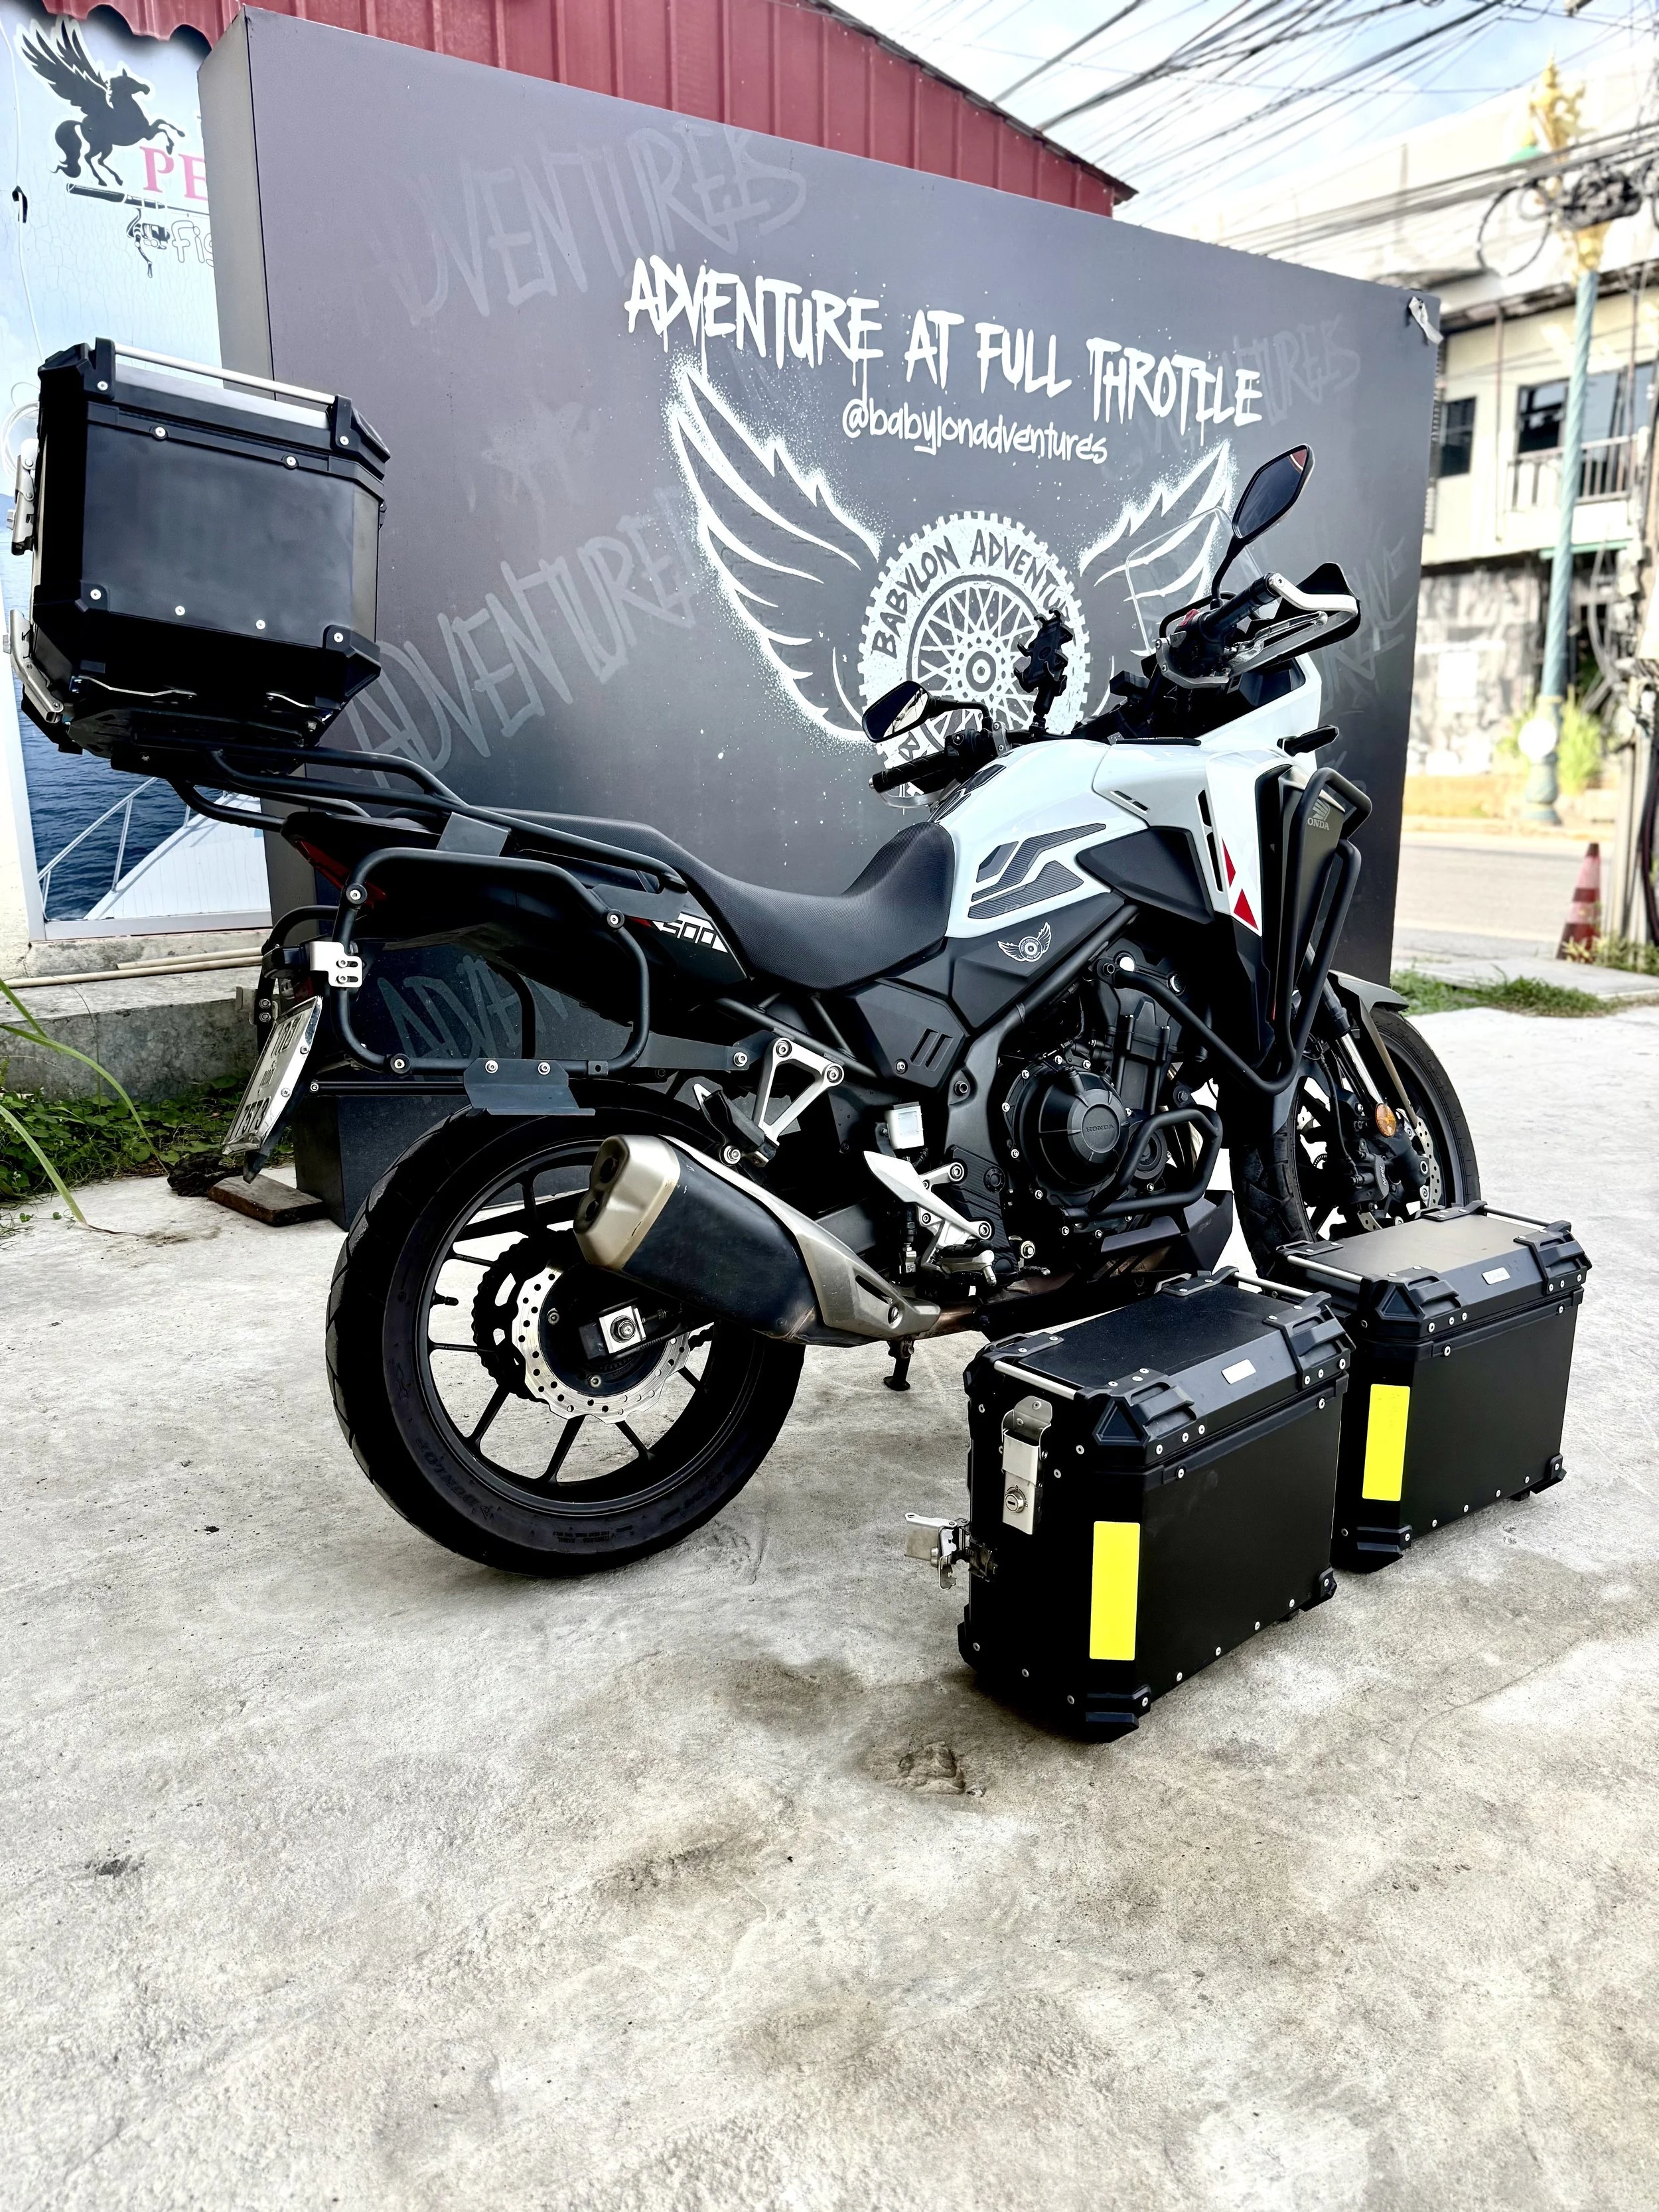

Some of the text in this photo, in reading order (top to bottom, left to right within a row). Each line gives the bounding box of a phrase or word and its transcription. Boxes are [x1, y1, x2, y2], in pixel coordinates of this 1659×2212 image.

[624, 254, 1263, 438] ADVENTURE AT FULL THROTTLE
[842, 398, 1108, 465] @babylonadventures
[871, 535, 960, 659] BABYLON
[1307, 818, 1331, 830] ONDA
[234, 1097, 271, 1138] 7573
